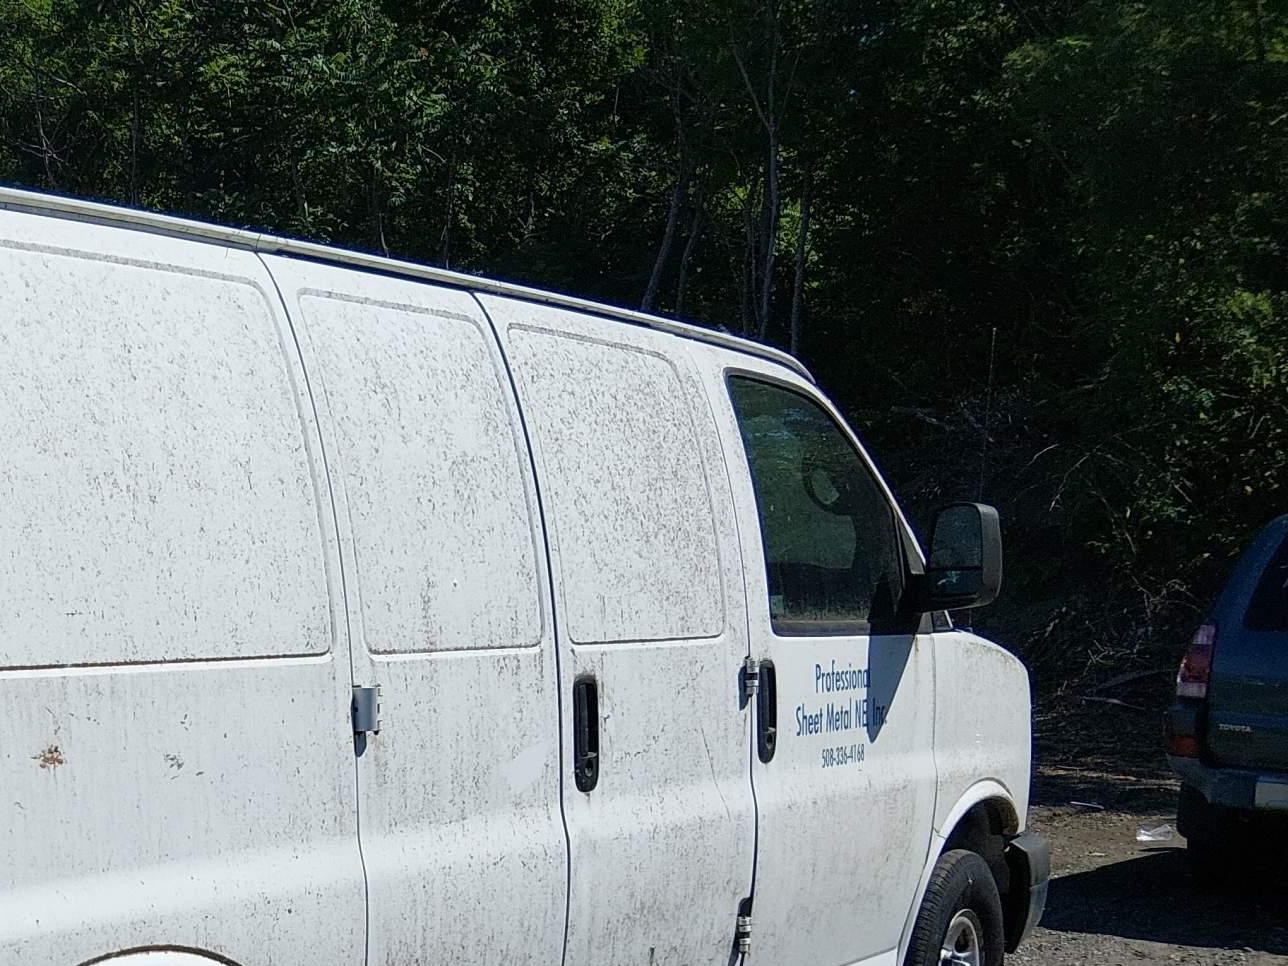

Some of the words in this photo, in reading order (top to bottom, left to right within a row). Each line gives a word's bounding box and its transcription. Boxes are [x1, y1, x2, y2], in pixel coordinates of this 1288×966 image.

[795, 703, 823, 736] Sheet
[826, 698, 852, 732] Metal
[855, 699, 868, 728] NE
[872, 698, 887, 727] Inc.
[822, 743, 865, 768] 508-336-4168
